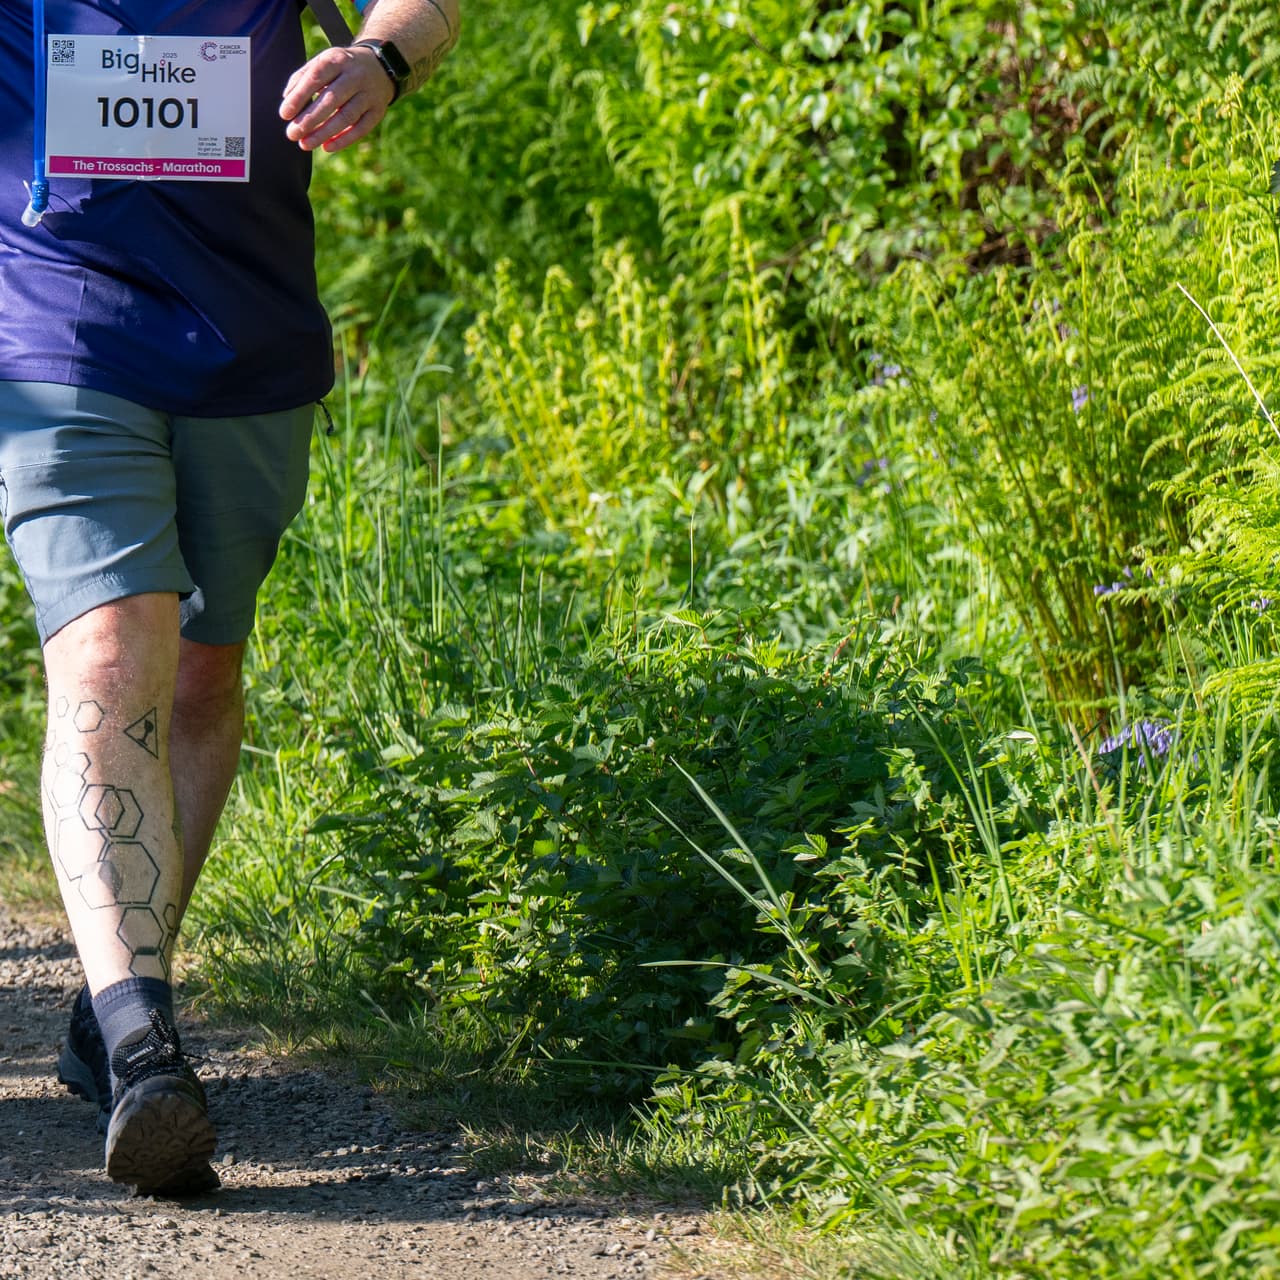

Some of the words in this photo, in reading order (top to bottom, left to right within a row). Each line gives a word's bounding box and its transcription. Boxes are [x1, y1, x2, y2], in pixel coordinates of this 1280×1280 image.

[102, 48, 139, 74] Big
[141, 60, 196, 83] Hike
[97, 96, 198, 129] 10101
[73, 160, 95, 171] The
[96, 161, 154, 172] Trossachs
[163, 161, 221, 173] Marathon
